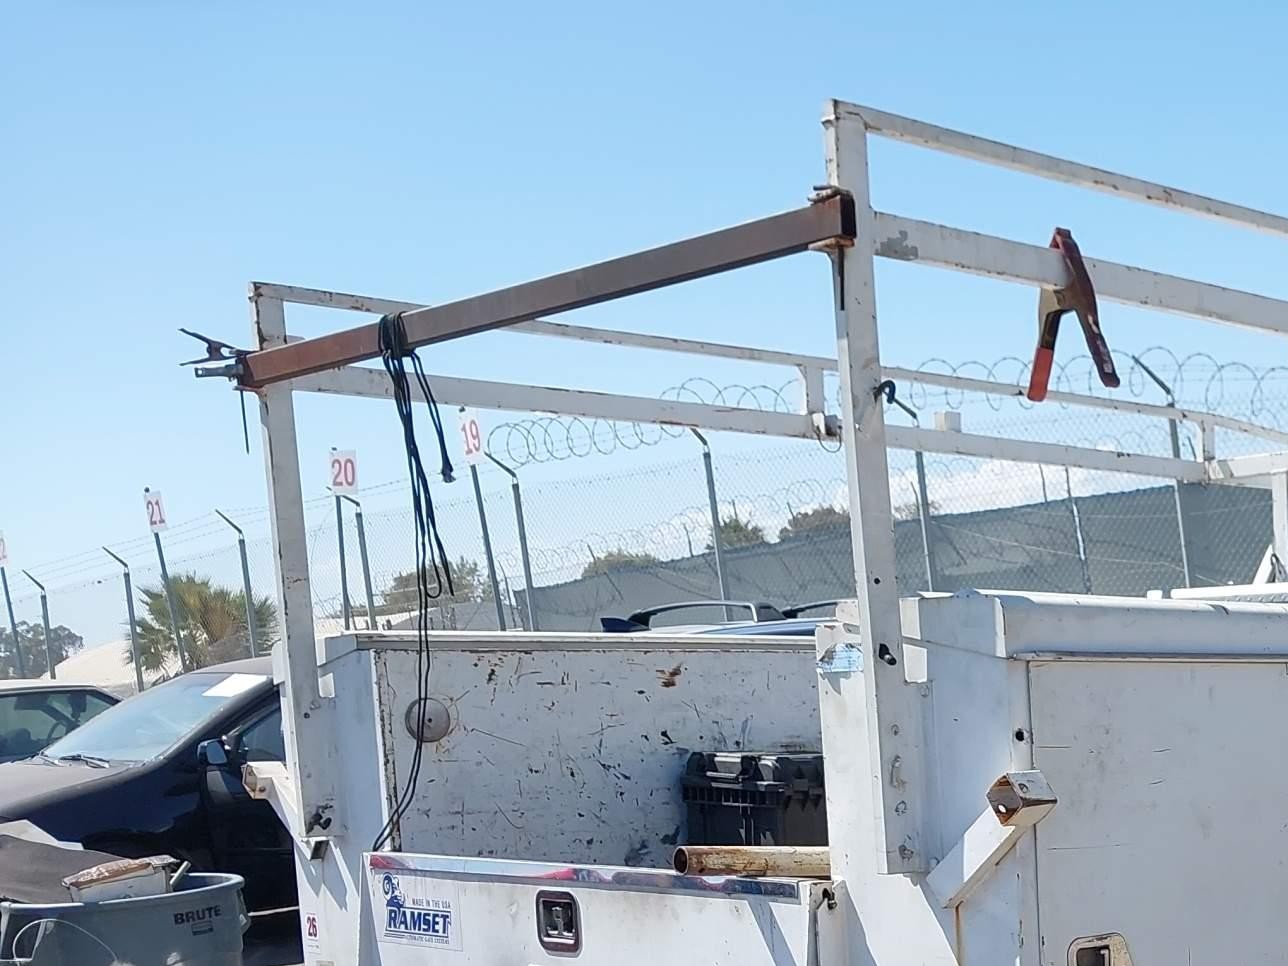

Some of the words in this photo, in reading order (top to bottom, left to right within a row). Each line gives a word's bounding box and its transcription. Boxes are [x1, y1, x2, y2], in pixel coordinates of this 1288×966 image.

[461, 419, 481, 455] 19
[331, 458, 355, 487] 20
[146, 499, 165, 525] 21
[174, 905, 222, 925] BRUTE
[307, 916, 318, 938] 26
[388, 909, 450, 934] RAMSET
